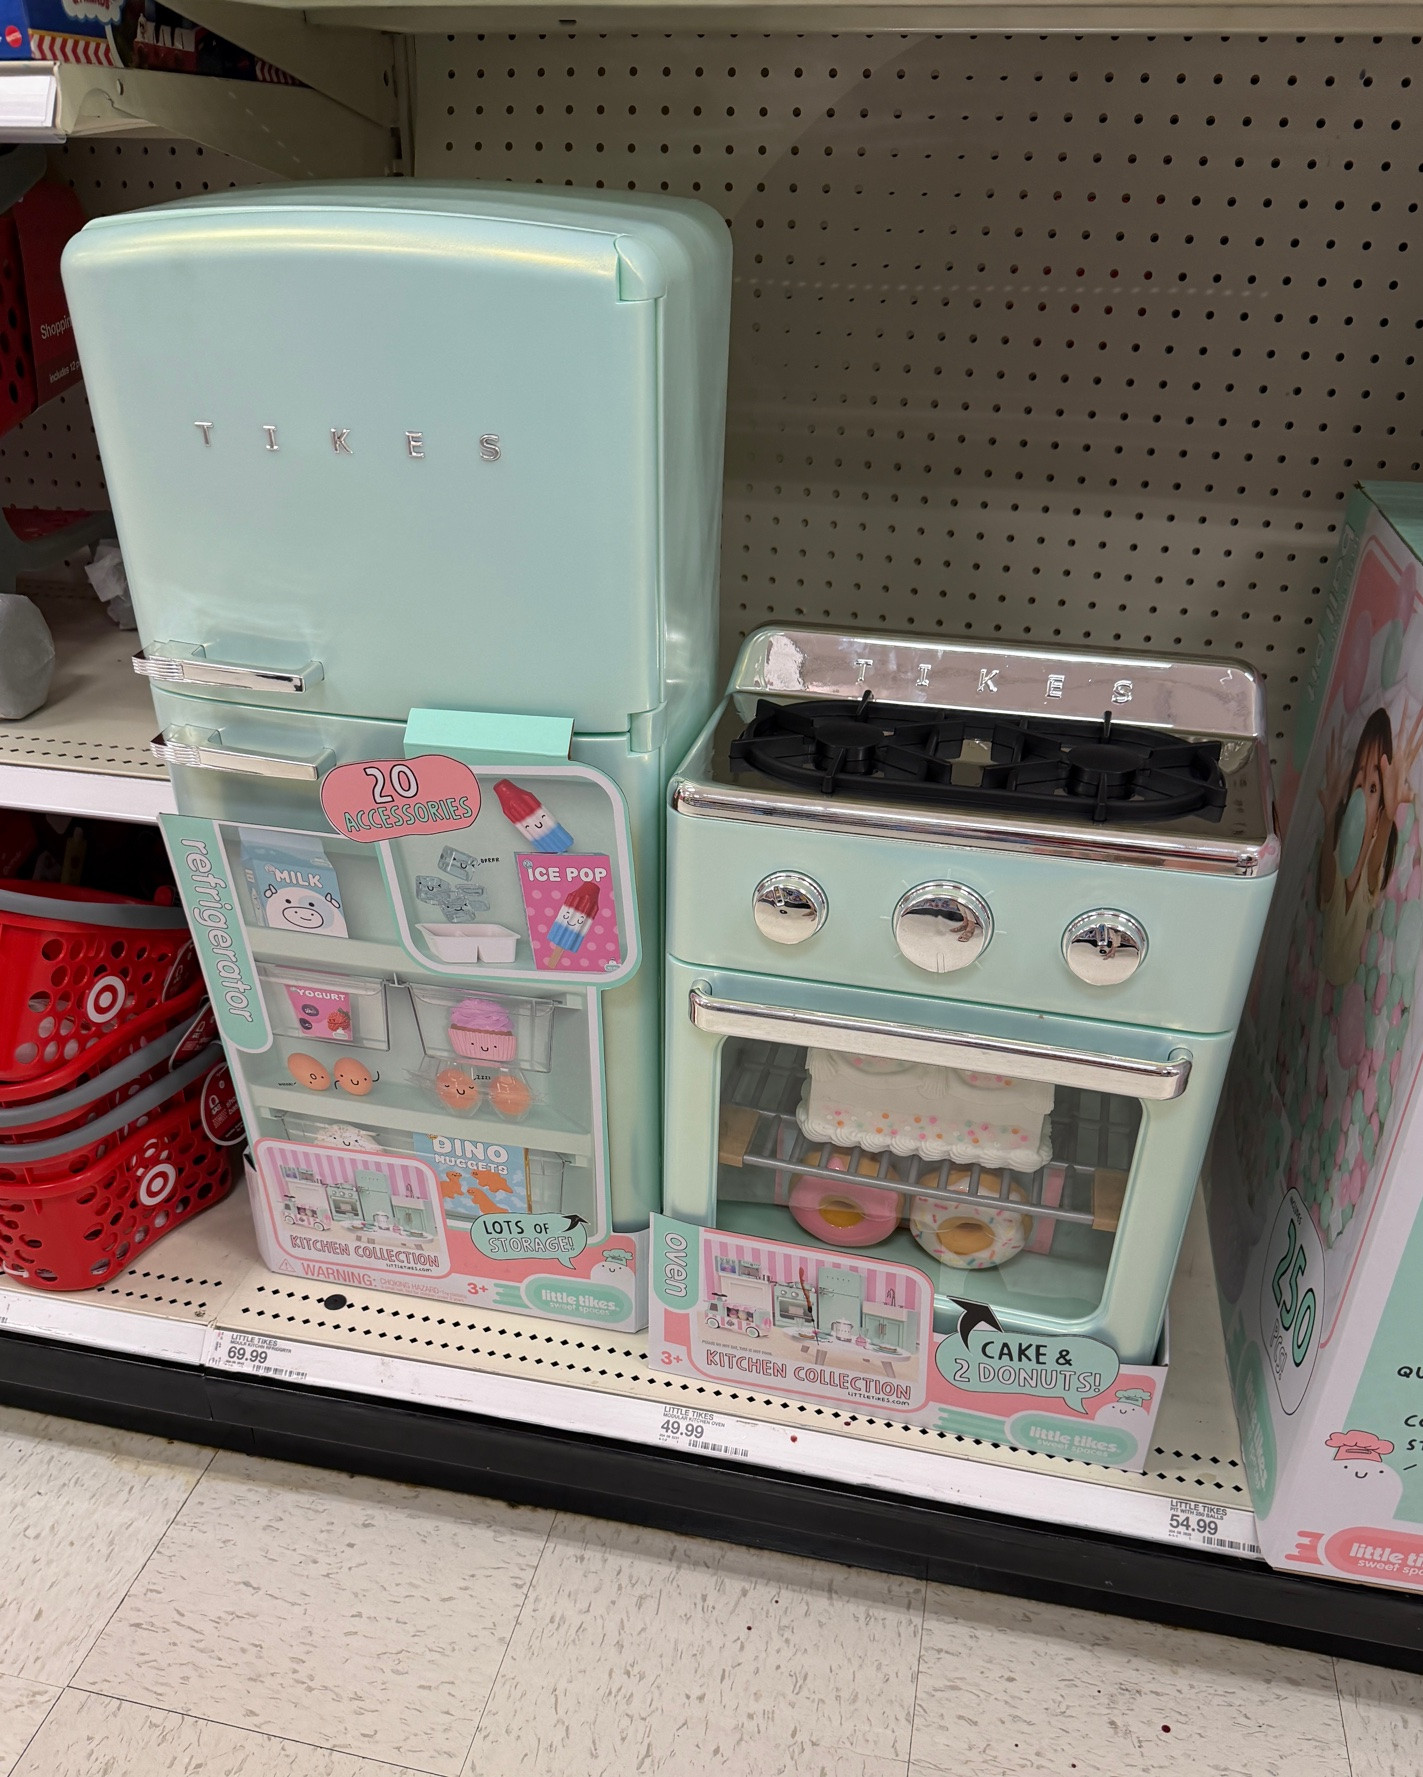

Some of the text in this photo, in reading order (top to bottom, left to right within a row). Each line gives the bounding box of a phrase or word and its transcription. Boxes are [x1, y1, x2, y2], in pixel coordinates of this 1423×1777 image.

[194, 420, 502, 462] TIKES
[854, 658, 1133, 705] TIKES
[363, 763, 419, 804] 20
[343, 796, 473, 832] ACCESSORIES
[274, 868, 323, 888] MILK
[528, 867, 607, 882] ICE POP
[181, 838, 253, 1023] refrigerator
[297, 989, 345, 1001] YOGURT
[432, 1136, 509, 1163] DINO
[434, 1154, 509, 1175] NUGGETS
[483, 1220, 550, 1235] LOTS OF
[290, 1235, 440, 1268] KITCHEN COLLECTION
[488, 1236, 575, 1253] STORAGE!
[301, 1262, 377, 1287] WARNING:
[664, 1232, 688, 1298] oven
[467, 1282, 489, 1295] 3+
[541, 1289, 577, 1304] little
[1272, 1218, 1316, 1367] 250
[550, 1302, 609, 1315] sweet spaces
[231, 1333, 256, 1344] LITTLE
[256, 1337, 278, 1347] TIKES
[227, 1345, 268, 1364] 69.99
[660, 1351, 683, 1365] 3+
[981, 1340, 1073, 1366] CAKE &
[706, 1349, 911, 1400] KITCHEN COLLECTION
[954, 1358, 1101, 1393] 2 DONUTS!
[663, 1412, 689, 1421] MODULAR
[688, 1416, 710, 1425] KITCHEN
[664, 1405, 714, 1420] LITTLE TIKES
[660, 1419, 704, 1439] 49.99
[1029, 1426, 1071, 1444] little
[1170, 1499, 1228, 1516] LITTLE TIKES
[1169, 1513, 1218, 1535] 54.99
[1349, 1543, 1402, 1564] little
[1357, 1559, 1400, 1571] sweet
